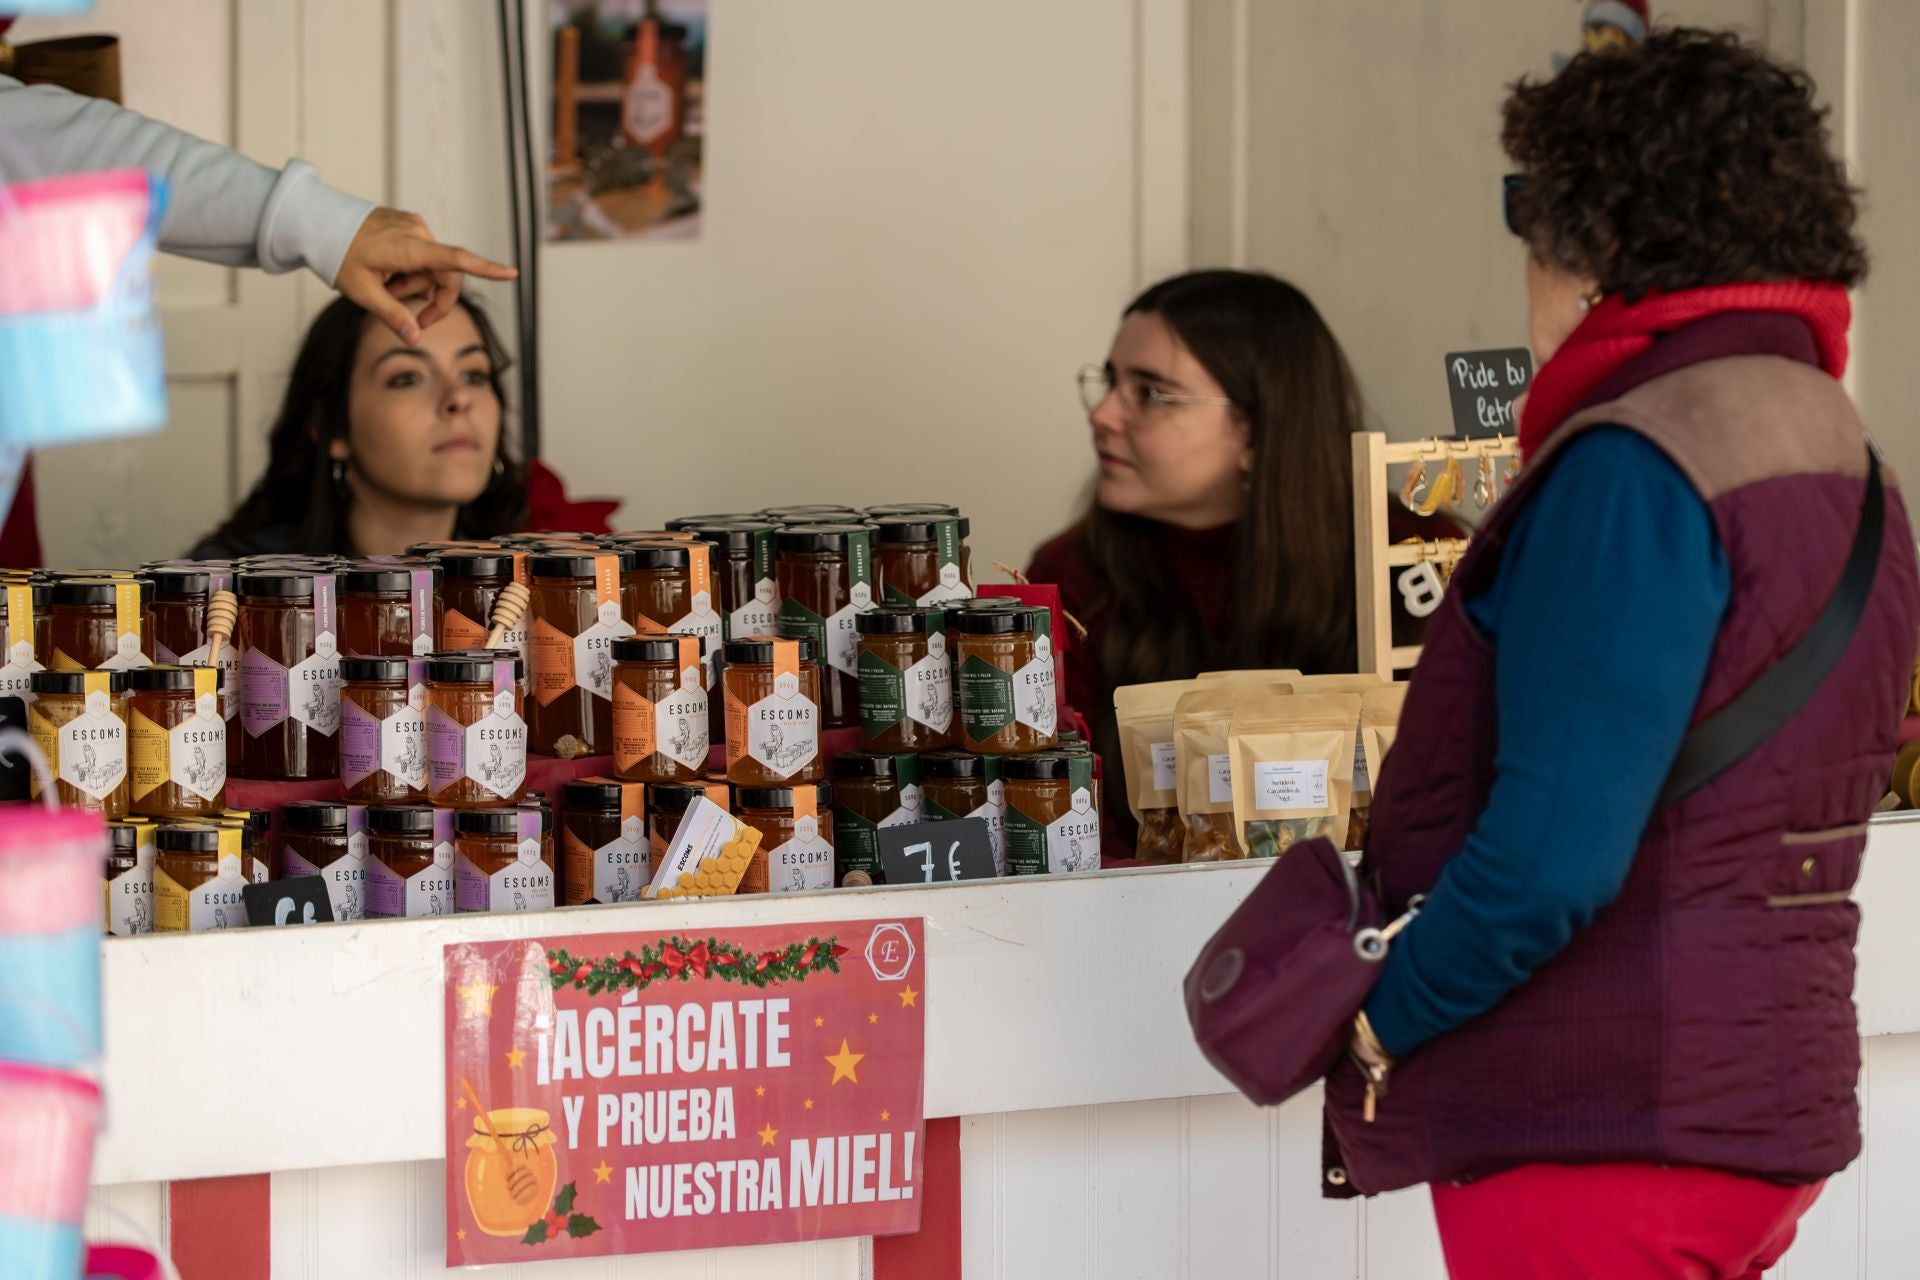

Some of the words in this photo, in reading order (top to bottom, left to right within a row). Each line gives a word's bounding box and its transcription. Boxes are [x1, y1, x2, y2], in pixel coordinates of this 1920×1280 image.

[1452, 357, 1499, 389] Pide
[1506, 357, 1526, 386] tu
[1477, 395, 1512, 428] letr
[303, 668, 340, 680] ESCOM
[669, 702, 707, 715] ESCOMS
[761, 709, 810, 721] ESCOMS
[72, 727, 120, 740] ESCOMS
[184, 730, 224, 743] ESCOMS
[480, 728, 522, 740] ESCOMS
[1060, 821, 1098, 837] ESCOMS
[677, 843, 693, 871] ESCOMS
[782, 851, 828, 865] ESCOMS
[504, 876, 549, 888] ESCOMS
[881, 940, 899, 963] E
[536, 987, 790, 1086] ¡ACÉRCATE
[562, 1095, 584, 1149] Y
[597, 1086, 736, 1147] PRUEBA
[625, 1157, 783, 1220] NUESTRA
[789, 1131, 916, 1208] MIEL!
